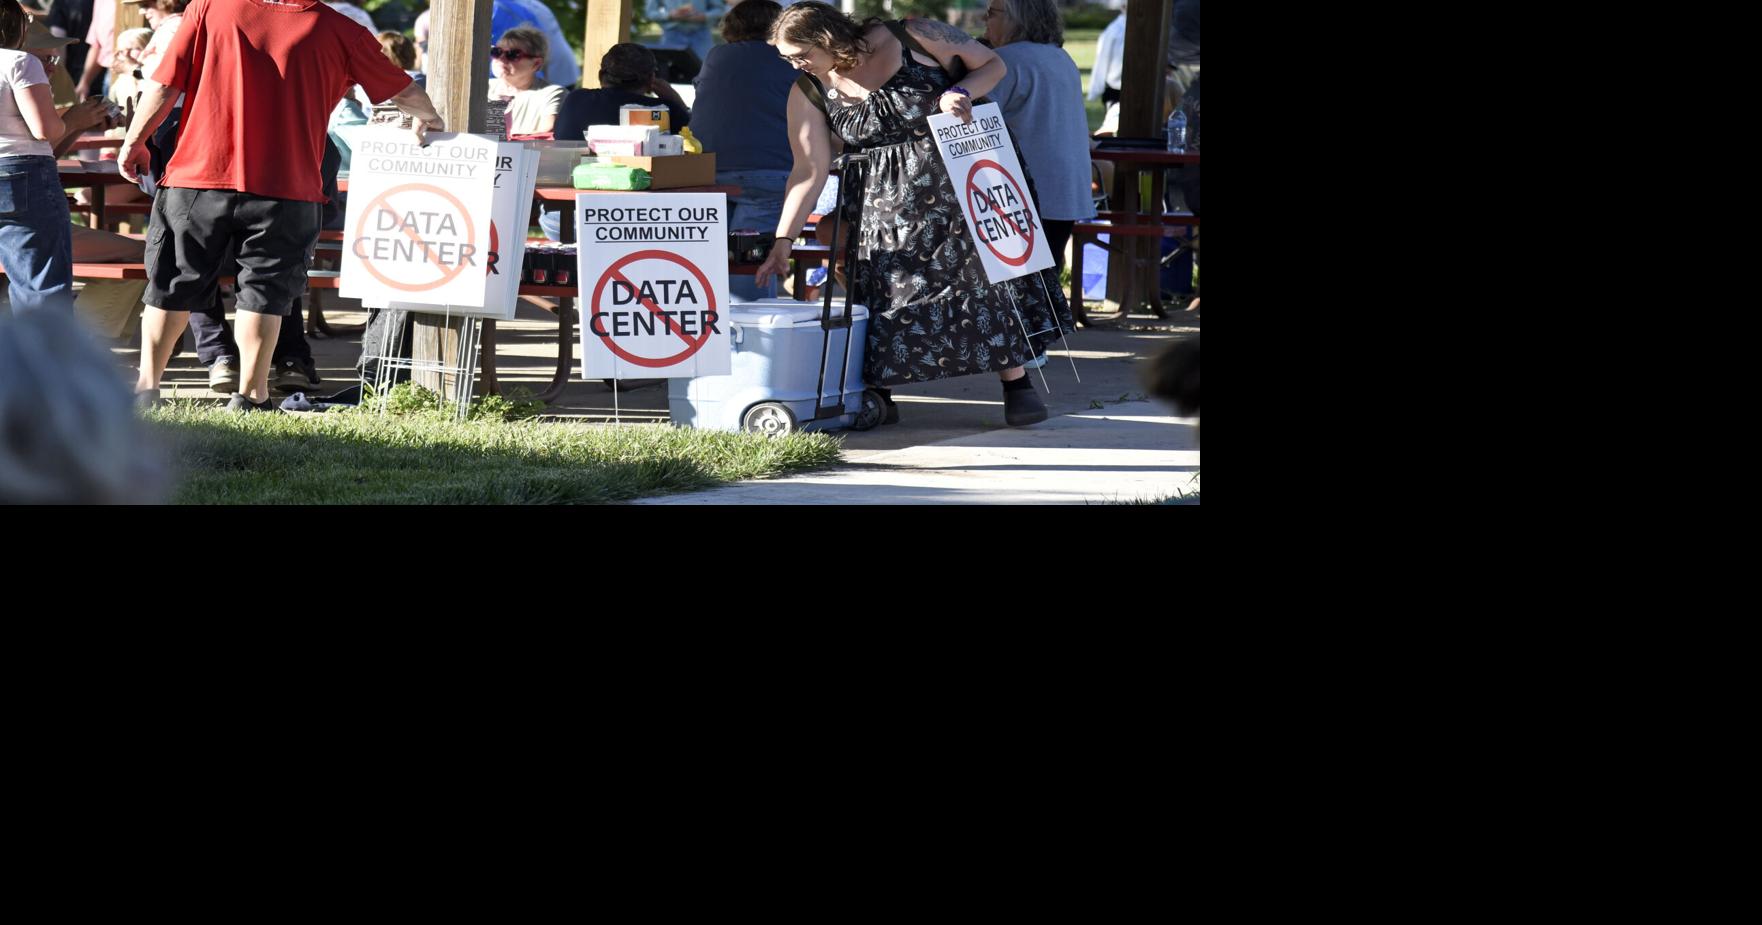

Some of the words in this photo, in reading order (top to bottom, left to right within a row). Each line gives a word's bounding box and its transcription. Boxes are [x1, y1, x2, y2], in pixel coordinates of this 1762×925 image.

[937, 120, 978, 141] PROTECT
[981, 115, 1002, 131] OUR
[360, 140, 442, 158] PROTECT
[450, 145, 489, 160] OUR
[948, 133, 1002, 157] COMMUNITY
[368, 158, 477, 177] COMMUNITY
[973, 183, 1019, 214] DATA
[376, 208, 458, 237] DATA
[585, 207, 673, 222] PROTECT
[678, 207, 719, 222] OUR
[974, 207, 1039, 245] CENTER
[595, 226, 709, 241] COMMUNITY
[352, 236, 477, 267] CENTER
[612, 279, 698, 305] DATA
[589, 310, 722, 337] CENTER
